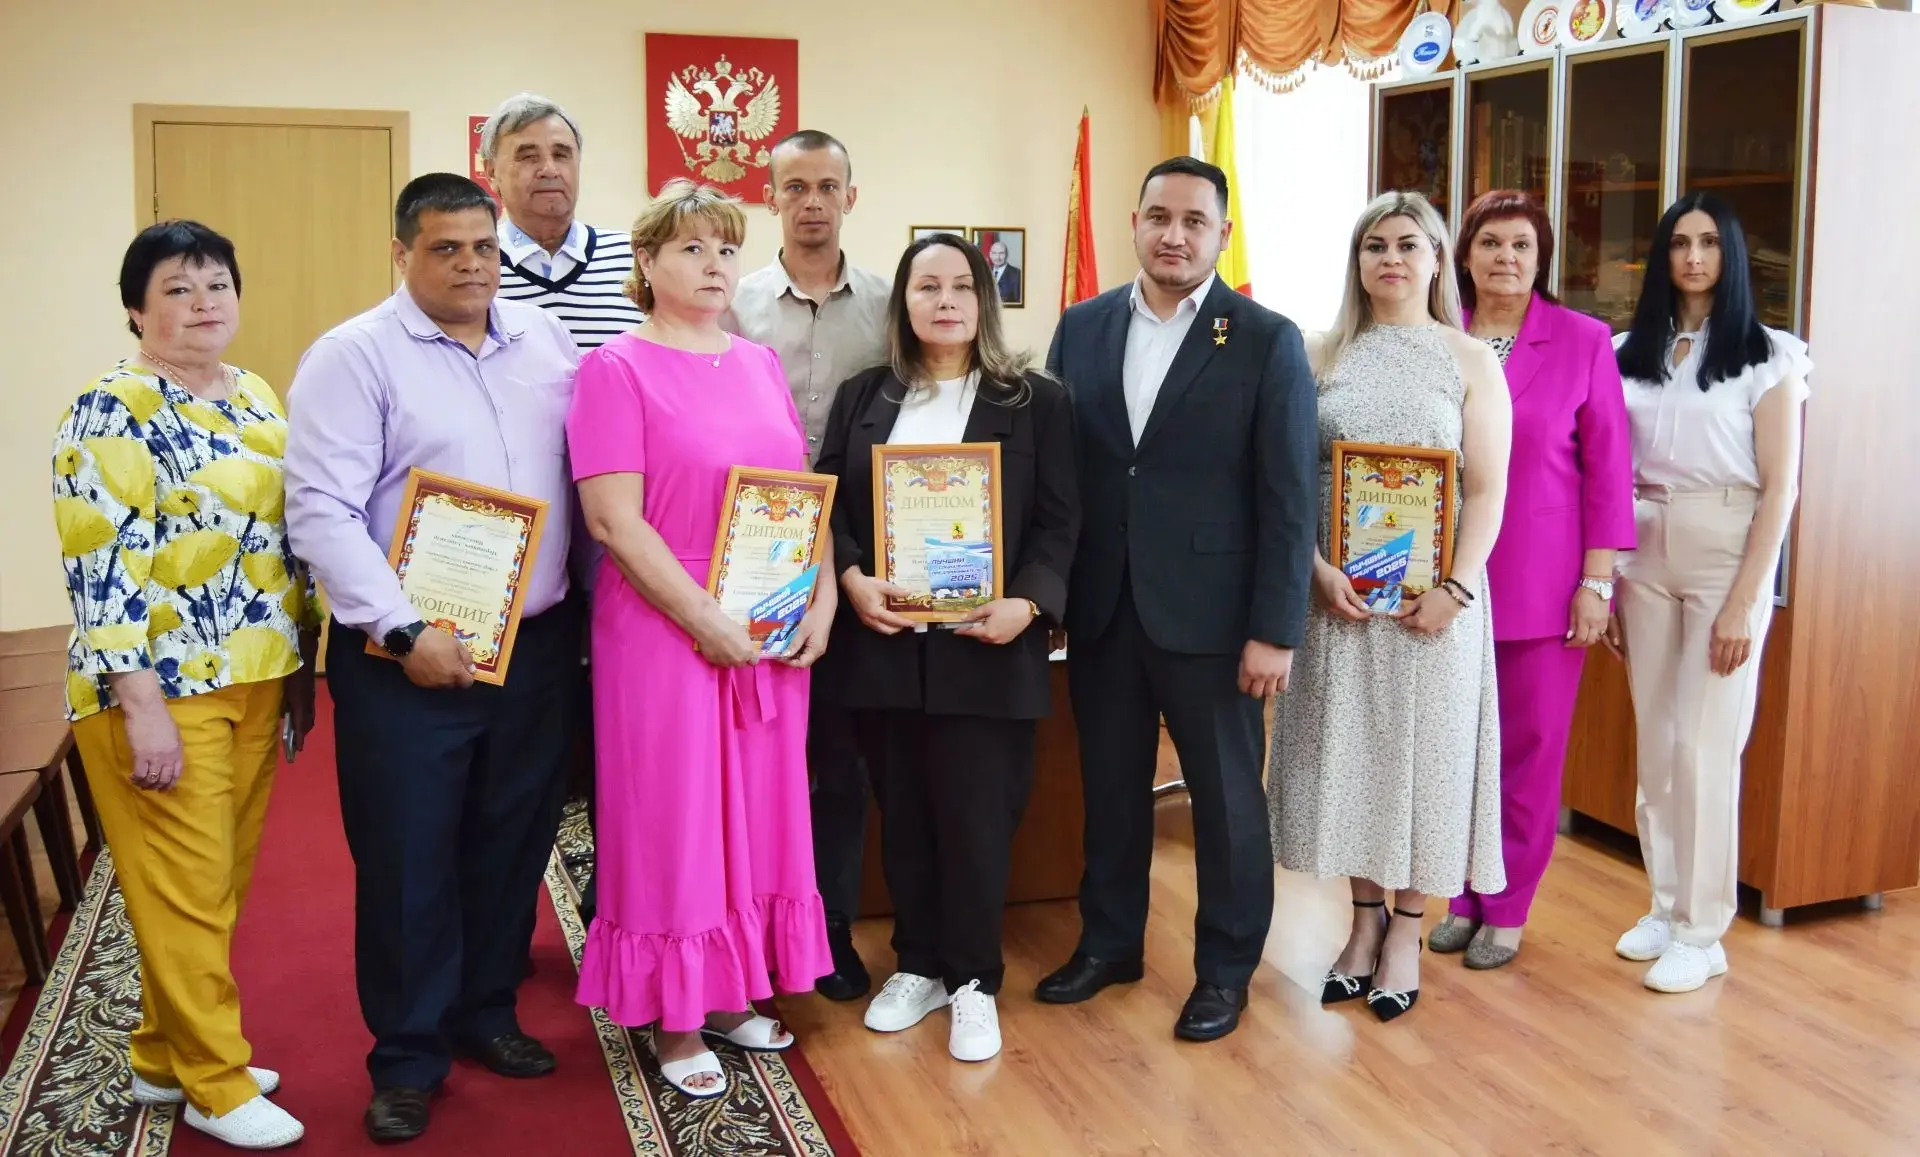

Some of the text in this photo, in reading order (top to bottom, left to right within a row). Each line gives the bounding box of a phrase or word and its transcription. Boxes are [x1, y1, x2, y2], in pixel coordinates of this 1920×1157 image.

[901, 495, 976, 509] ДИПЛОМ
[1356, 490, 1427, 507] ДИПЛОМ
[742, 523, 804, 540] ДИПЛОМ
[1349, 548, 1387, 574] ЛУЧШИЙ
[1352, 549, 1409, 580] ПРЕДПРИНИМАТЕЛЬ
[1376, 557, 1407, 578] 2025
[950, 574, 978, 582] 2025
[409, 593, 493, 624] ДИПЛОМ
[753, 586, 791, 617] ЛУЧШИЙ
[777, 594, 808, 620] 2025
